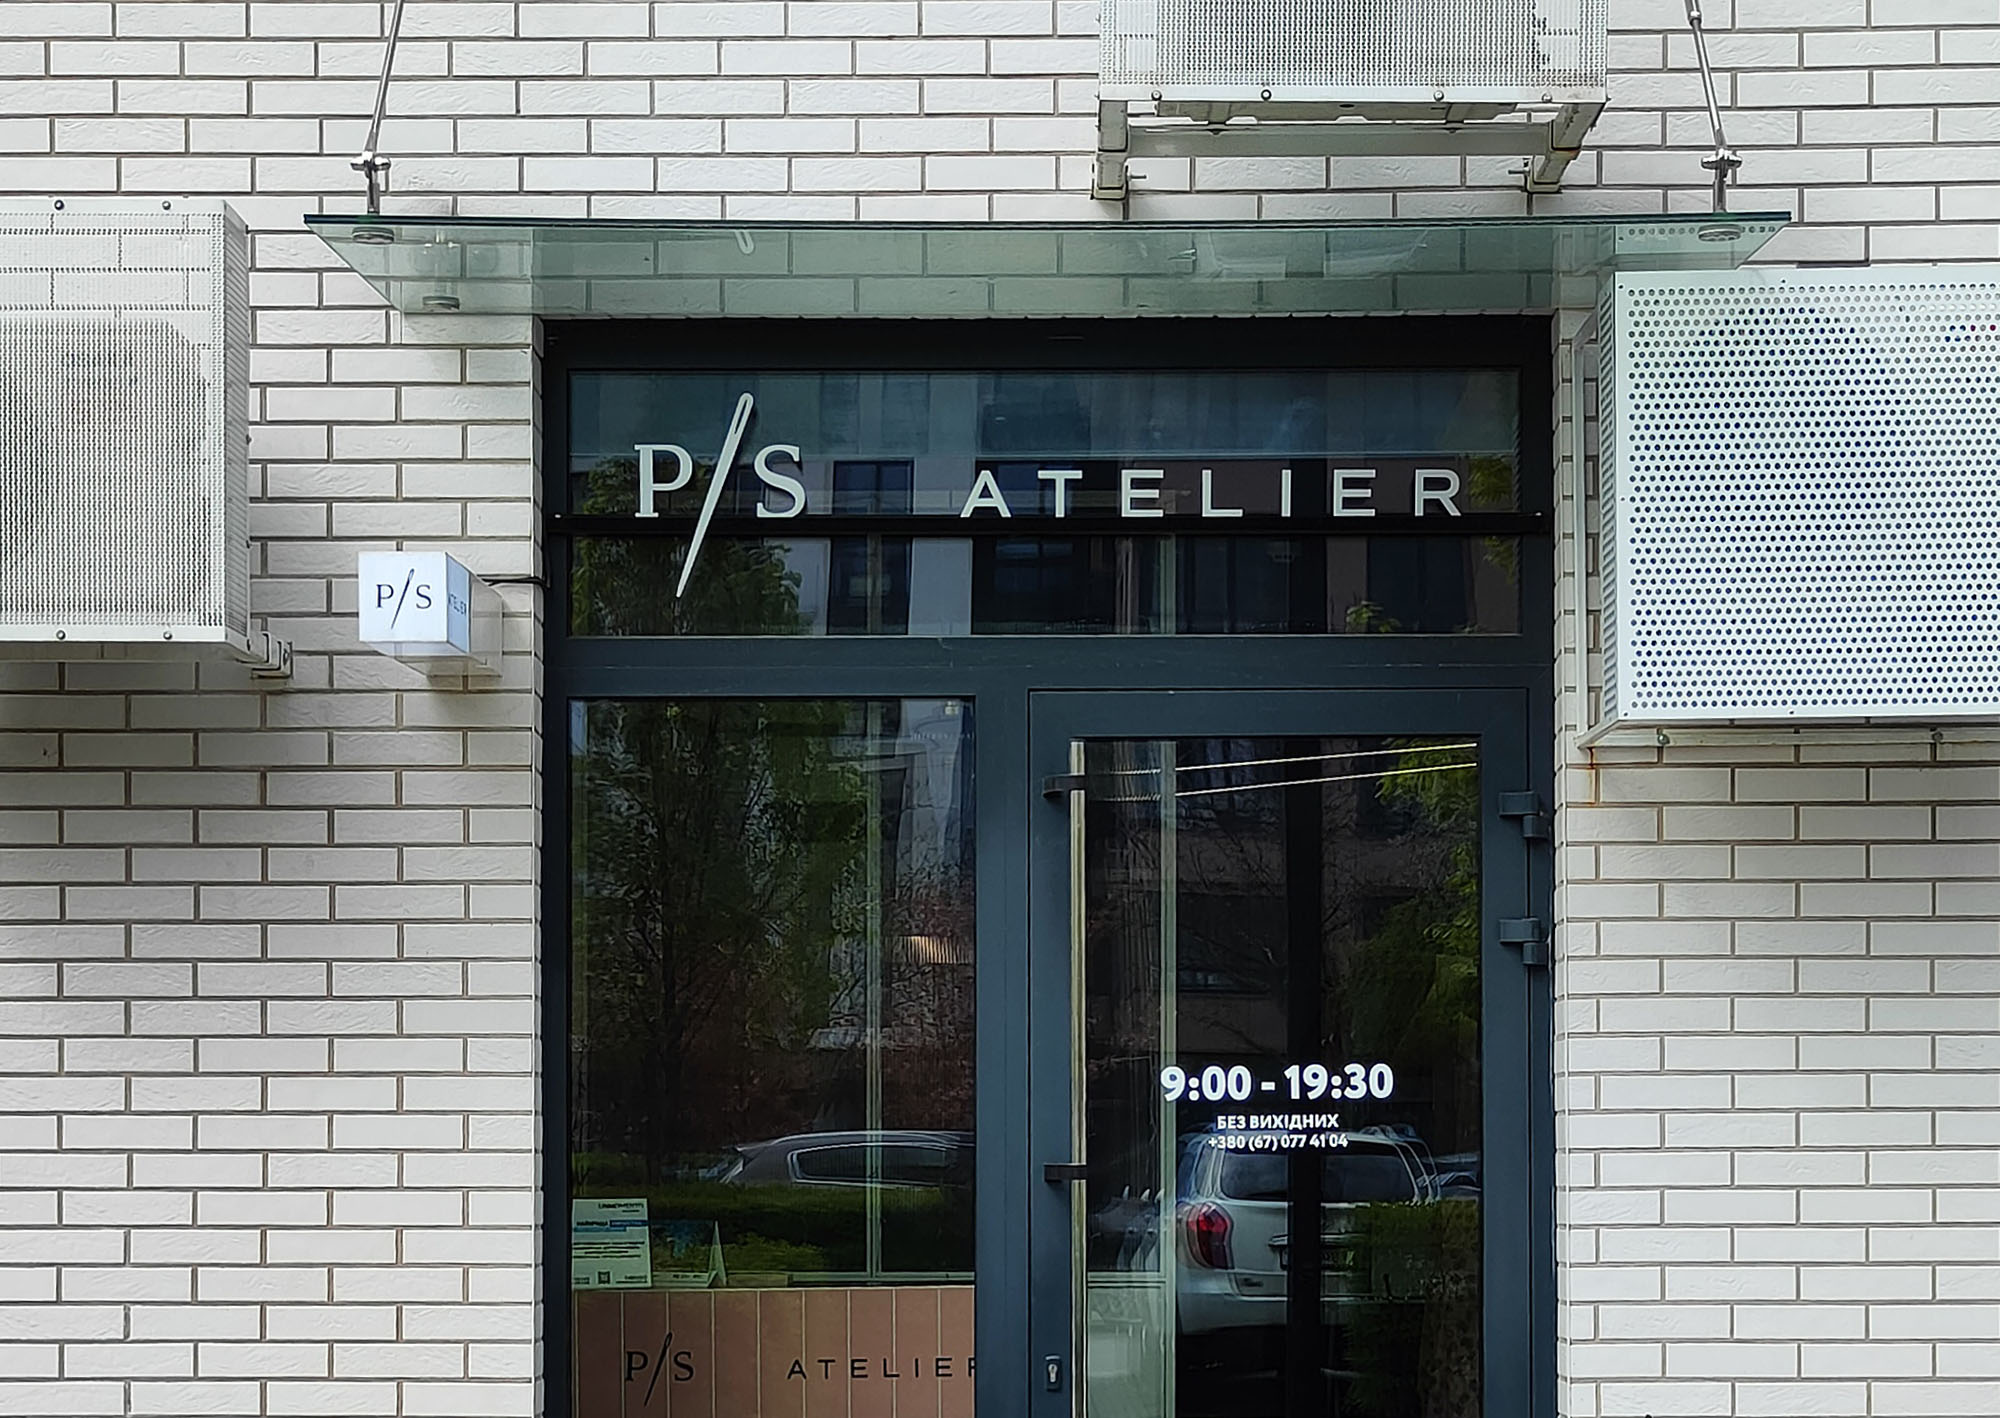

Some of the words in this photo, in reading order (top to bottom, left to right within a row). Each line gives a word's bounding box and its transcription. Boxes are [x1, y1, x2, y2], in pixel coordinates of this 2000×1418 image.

[634, 392, 806, 598] P/S
[960, 468, 1462, 518] ATELIER
[376, 568, 432, 630] P/S
[1160, 1065, 1251, 1101] 9:00
[1261, 1081, 1276, 1091] -
[1284, 1063, 1394, 1100] 19:30
[1208, 1135, 1246, 1149] +380
[1248, 1135, 1278, 1151] (67)
[1280, 1134, 1307, 1148] 077
[1309, 1134, 1326, 1148] 41
[1328, 1133, 1349, 1148] 04
[1217, 1115, 1246, 1130] БЕЗ
[1249, 1113, 1339, 1130] ВИХІДНИХ
[625, 1332, 694, 1406] P/S
